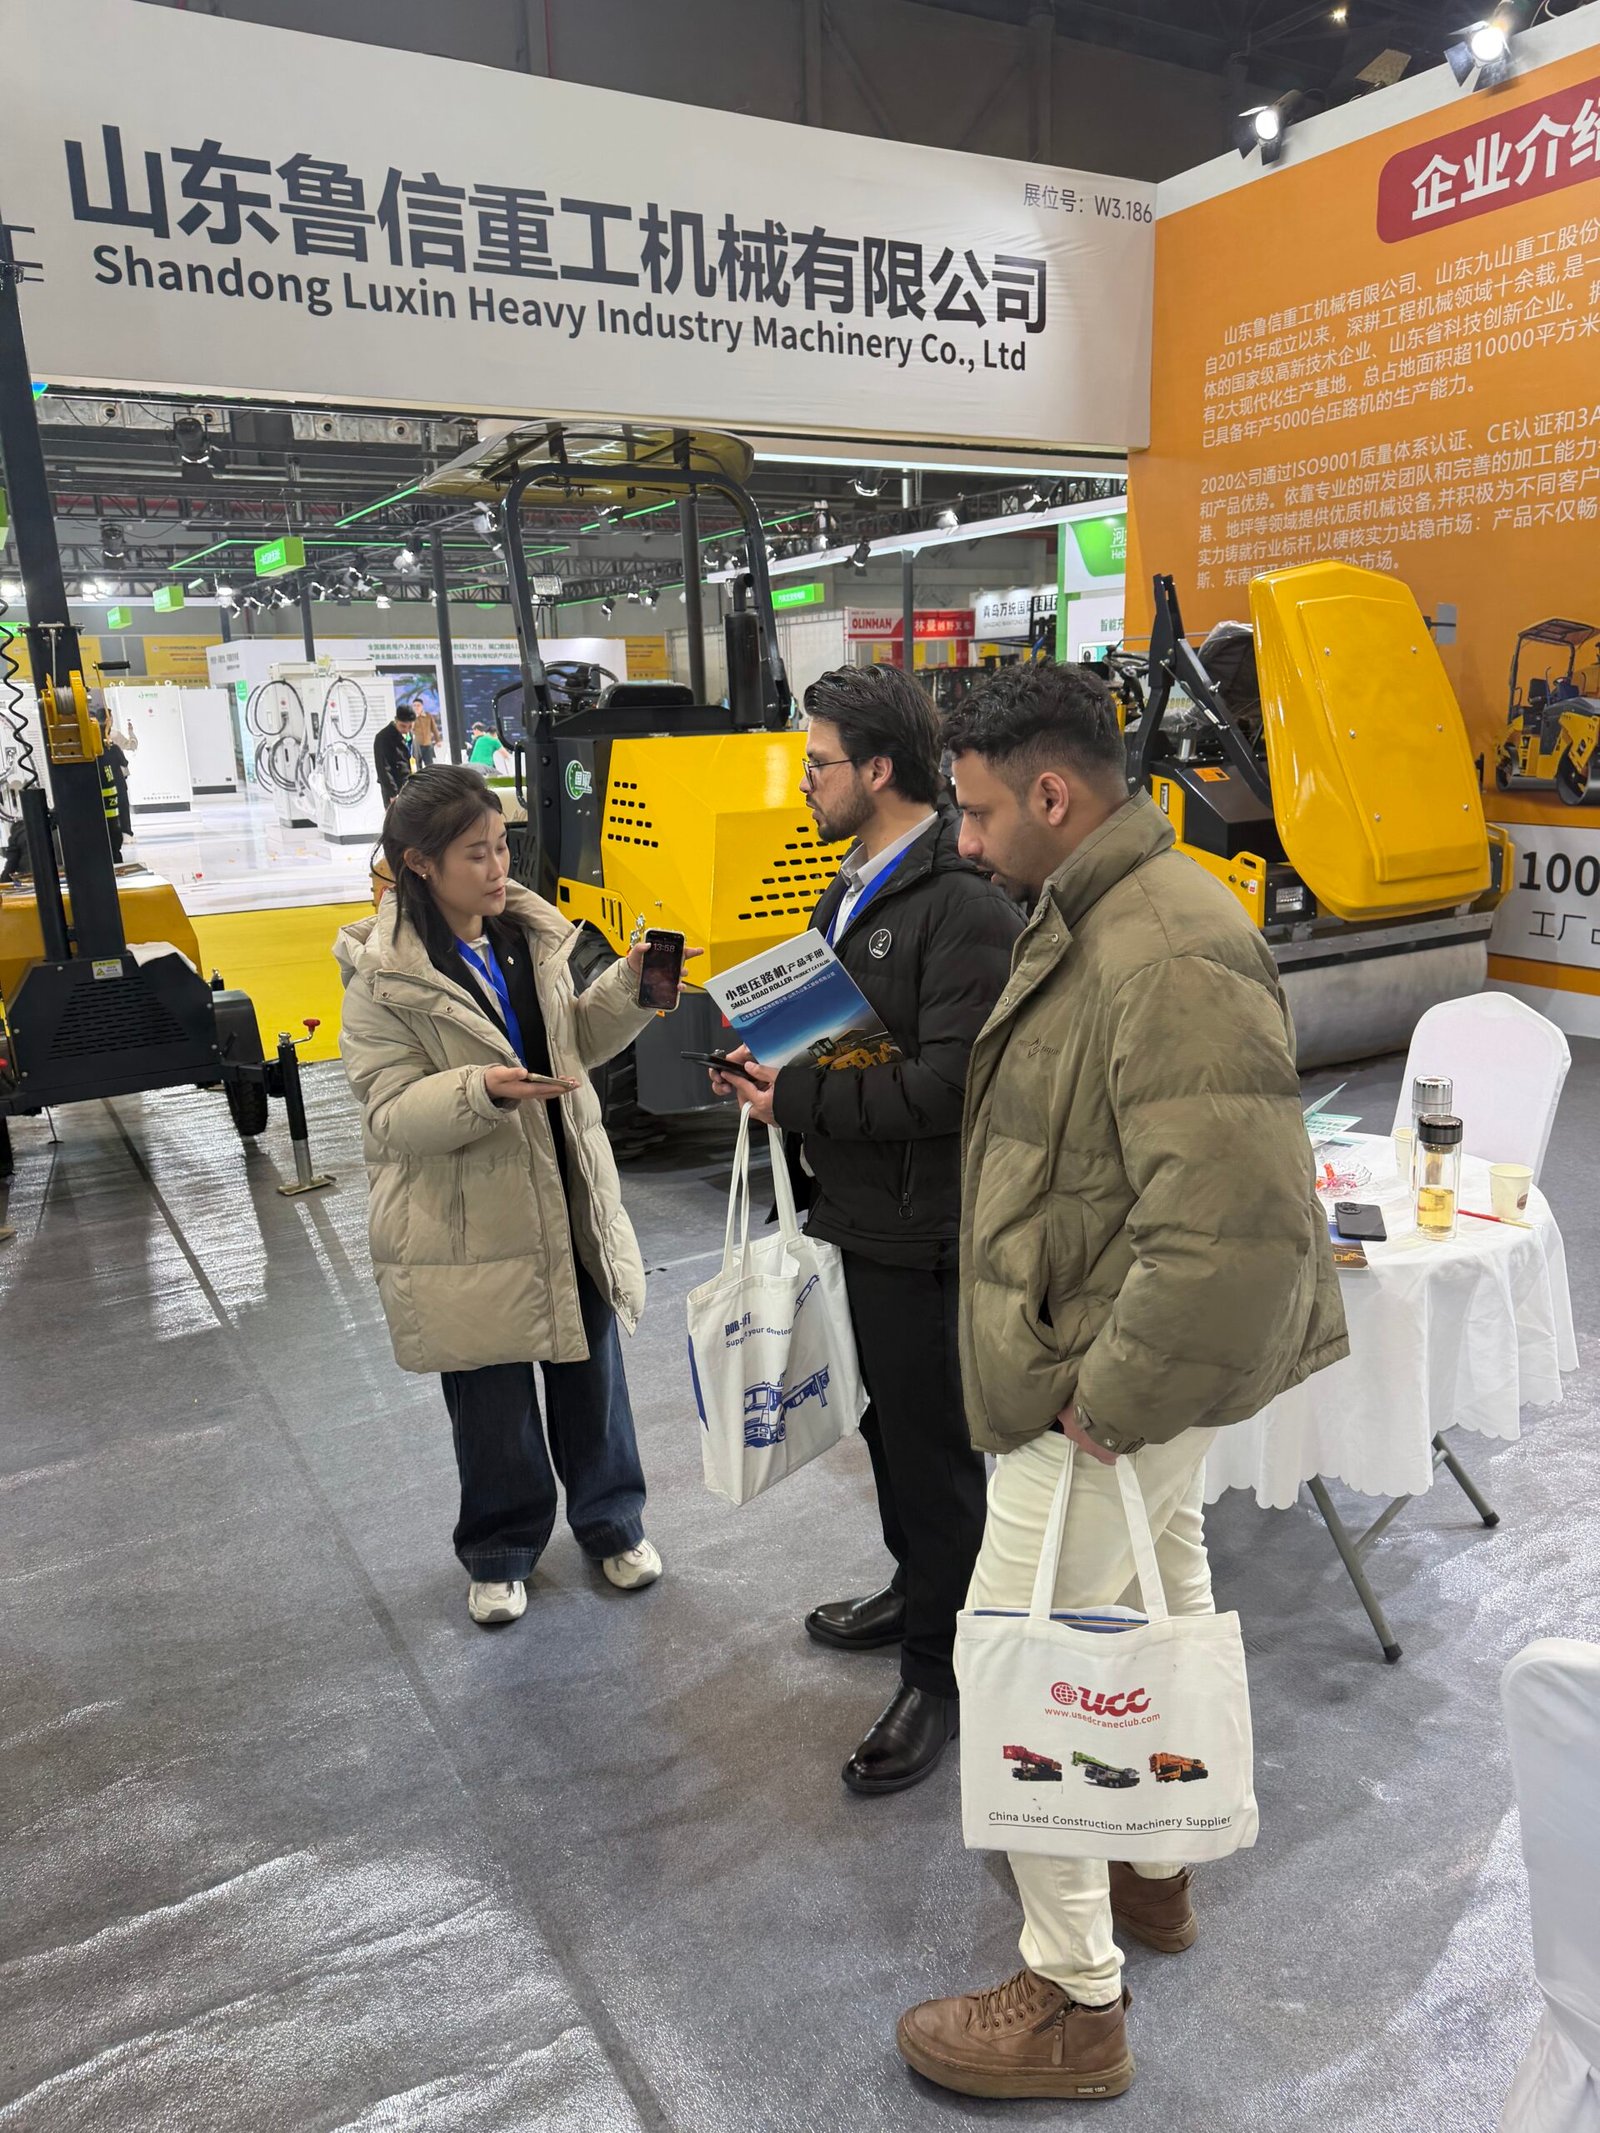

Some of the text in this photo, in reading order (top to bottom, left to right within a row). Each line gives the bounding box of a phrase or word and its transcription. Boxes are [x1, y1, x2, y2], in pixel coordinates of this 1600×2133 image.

[64, 124, 1047, 334] 山东鲁信重工机械有限公司
[93, 244, 1026, 373] Shandong Luxin Heavy Industry Machinery Co., Ltd
[1202, 373, 1473, 449] 已具备年产5000台压路机的生产能力。
[1199, 436, 1600, 519] 和产品优势。依靠专业的研发团队和完善的加工能力
[1112, 527, 1127, 545] 河
[1529, 910, 1600, 945] 工厂
[725, 948, 825, 1001] 小型压路机 产品手册
[730, 997, 752, 1010] SMALL
[751, 988, 770, 1001] ROAD
[769, 976, 793, 992] ROLLER
[1044, 1707, 1161, 1729] www.usedcraneclub.com
[988, 1811, 1232, 1832] China Used Construction Machinery Supplier
